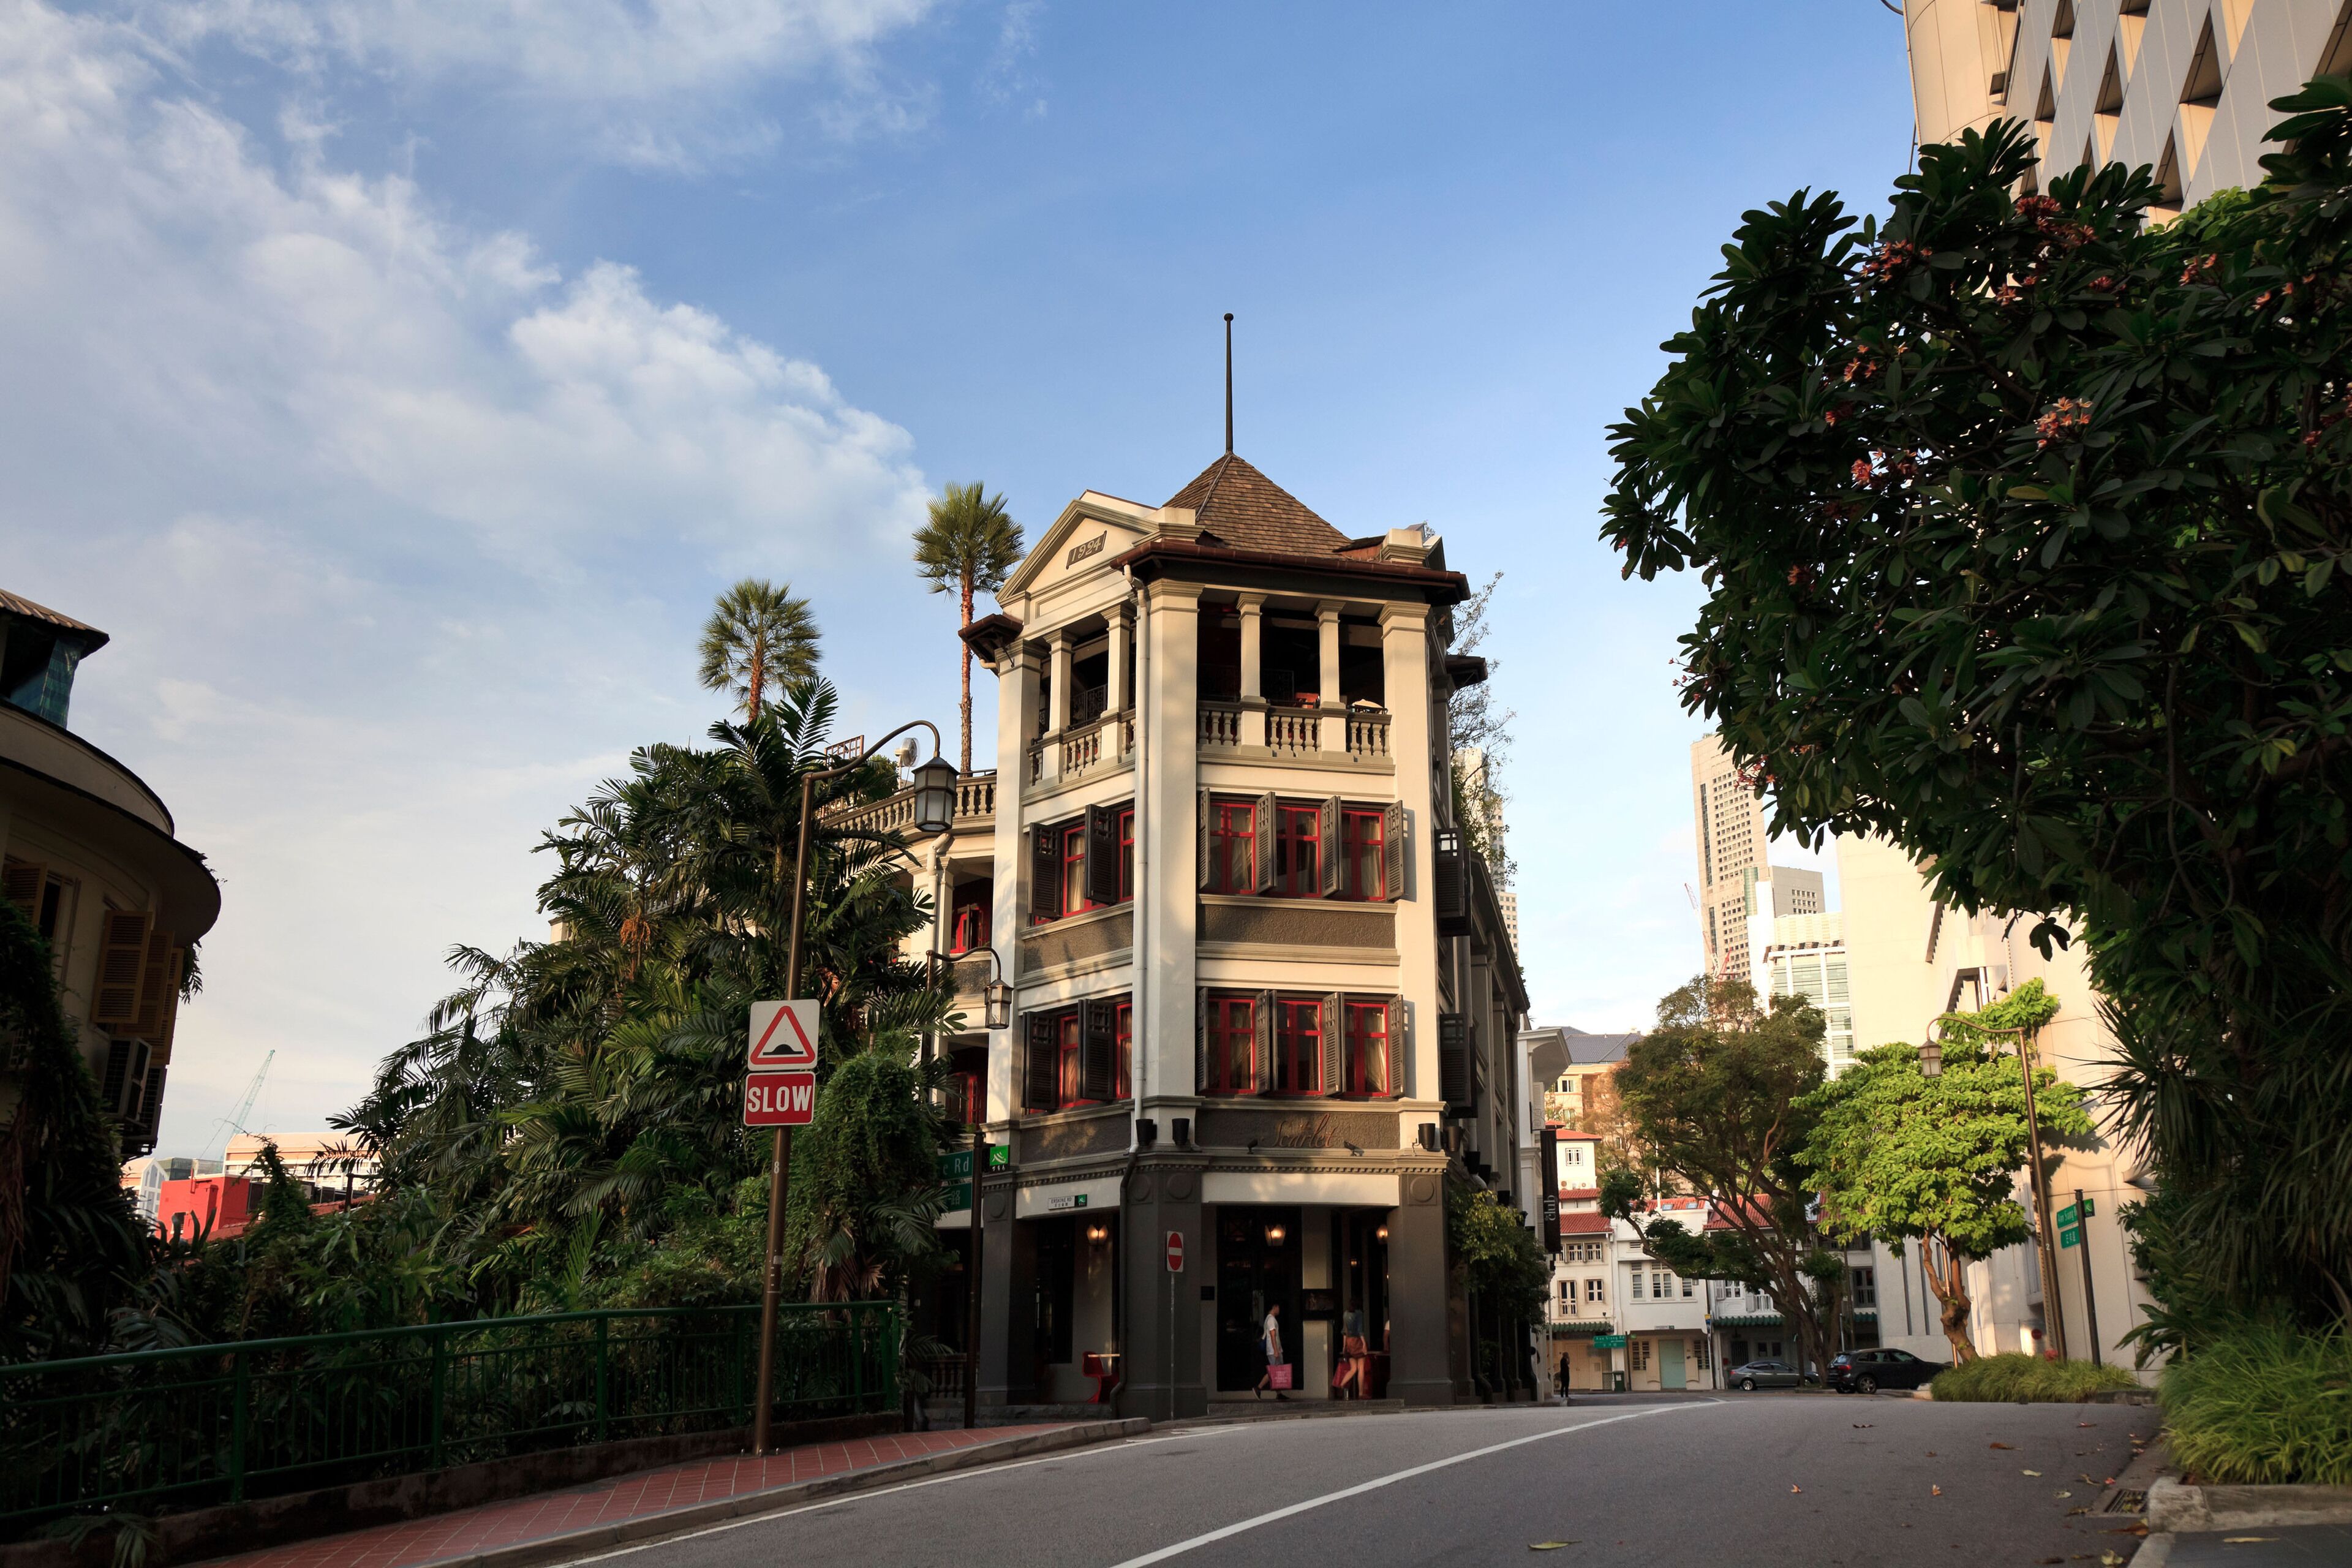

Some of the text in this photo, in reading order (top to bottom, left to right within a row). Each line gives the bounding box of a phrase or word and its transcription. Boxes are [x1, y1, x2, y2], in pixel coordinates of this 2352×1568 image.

[1072, 537, 1101, 562] 1924
[747, 1085, 812, 1112] SLOW
[1262, 1112, 1340, 1148] Scarlet
[774, 1161, 780, 1174] 8
[954, 1156, 970, 1174] Rd
[1544, 1195, 1556, 1221] club
